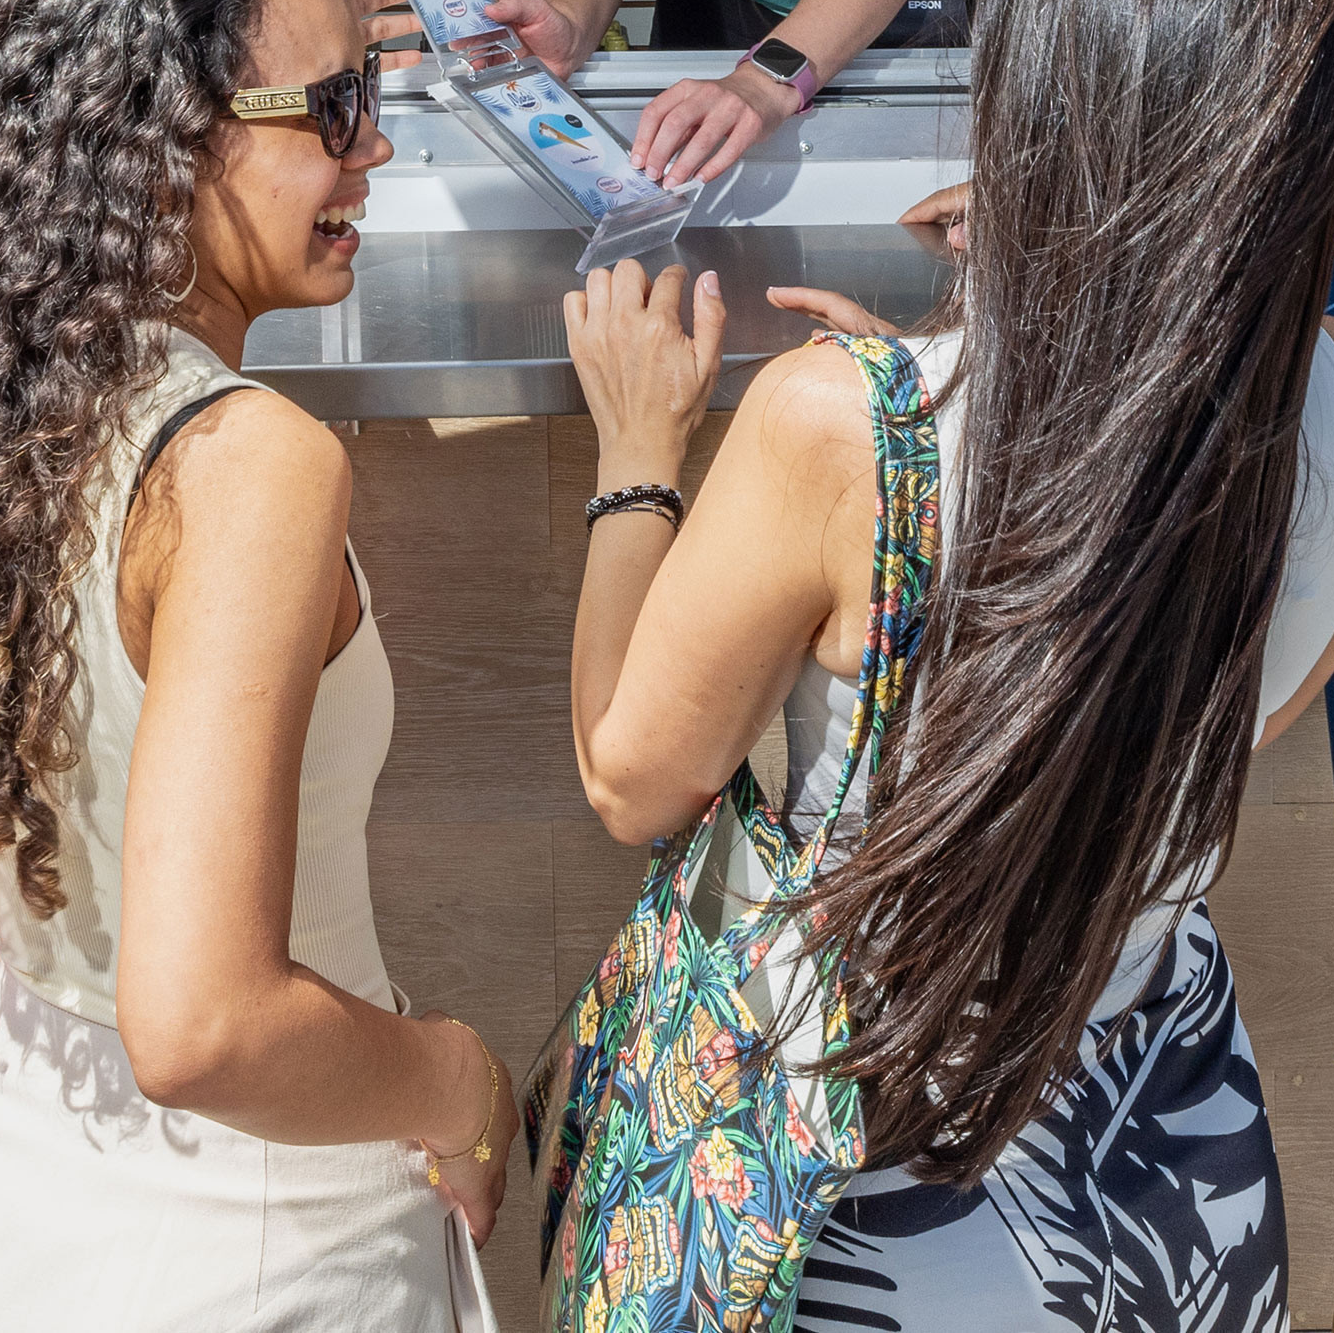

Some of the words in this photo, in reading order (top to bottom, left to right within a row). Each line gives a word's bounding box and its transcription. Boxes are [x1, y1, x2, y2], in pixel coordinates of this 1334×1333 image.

[908, 0, 942, 10] EPSON
[244, 94, 299, 109] GUESS
[507, 92, 536, 107] Makai
